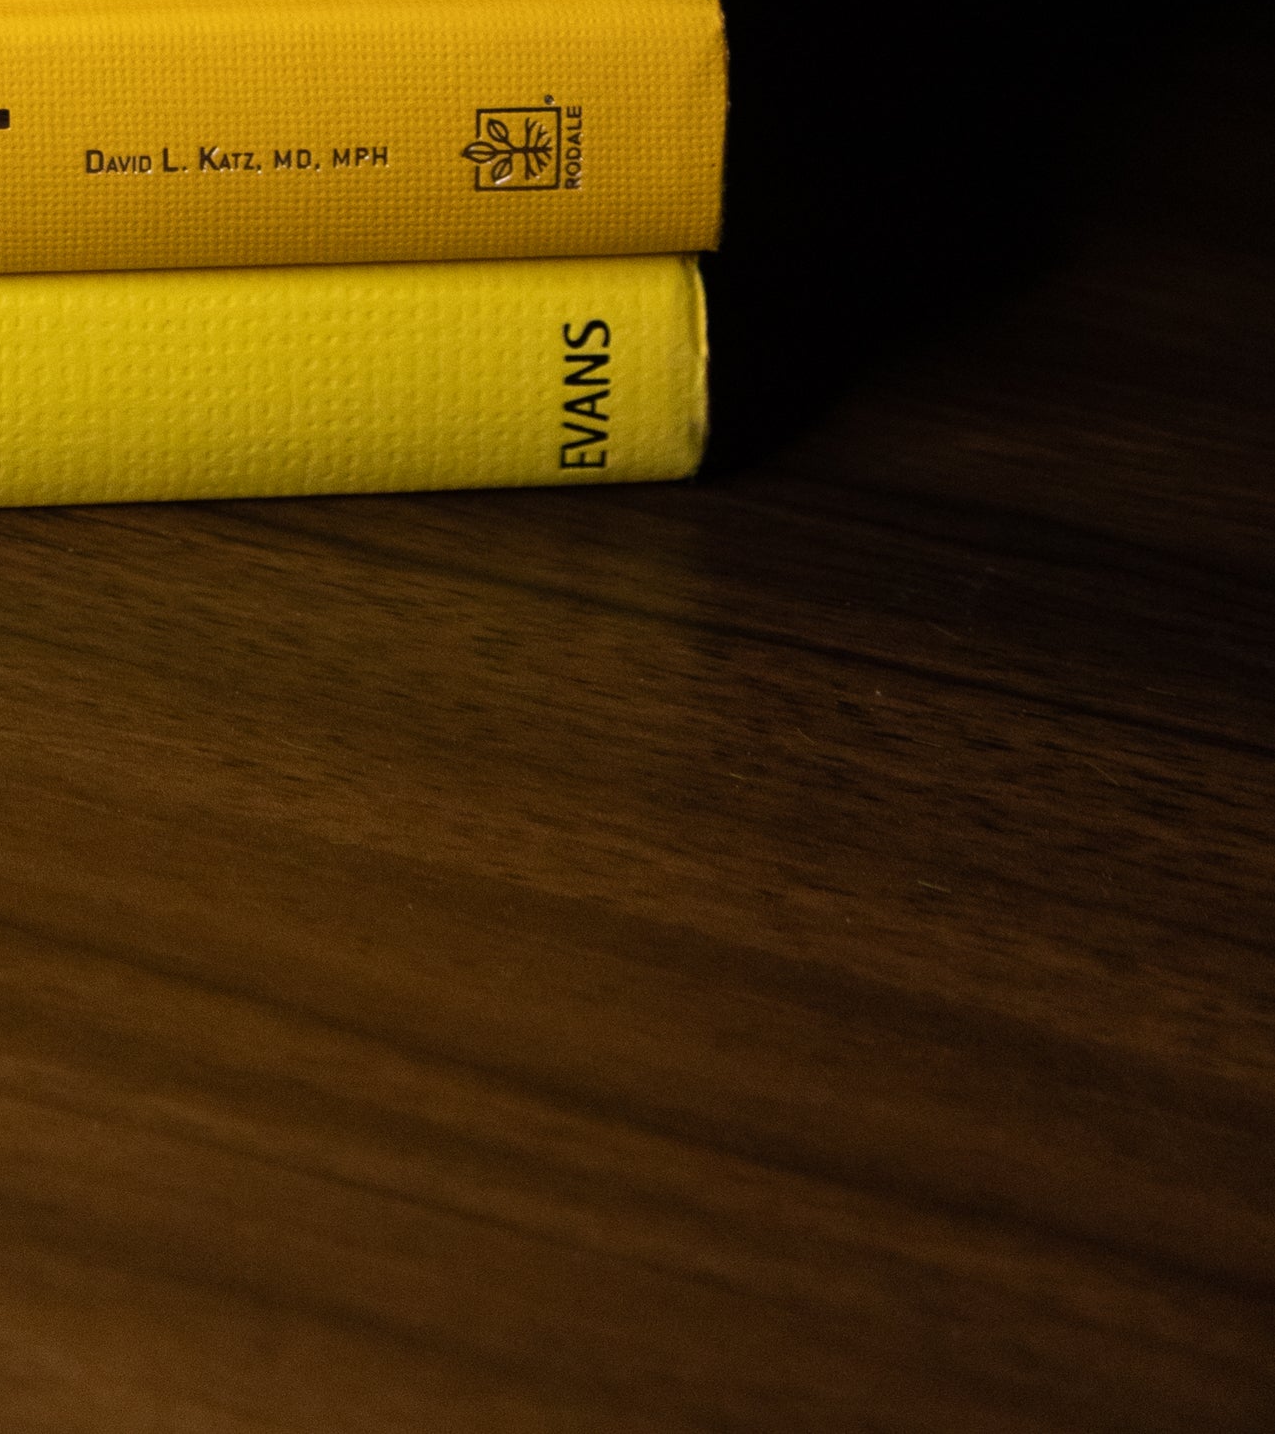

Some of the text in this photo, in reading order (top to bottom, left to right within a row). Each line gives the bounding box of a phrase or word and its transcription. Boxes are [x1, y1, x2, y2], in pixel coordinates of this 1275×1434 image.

[162, 147, 189, 172] L.
[274, 148, 321, 172] MD,
[333, 146, 389, 168] MPH
[565, 106, 583, 189] RODALE
[560, 319, 611, 468] EVANS
